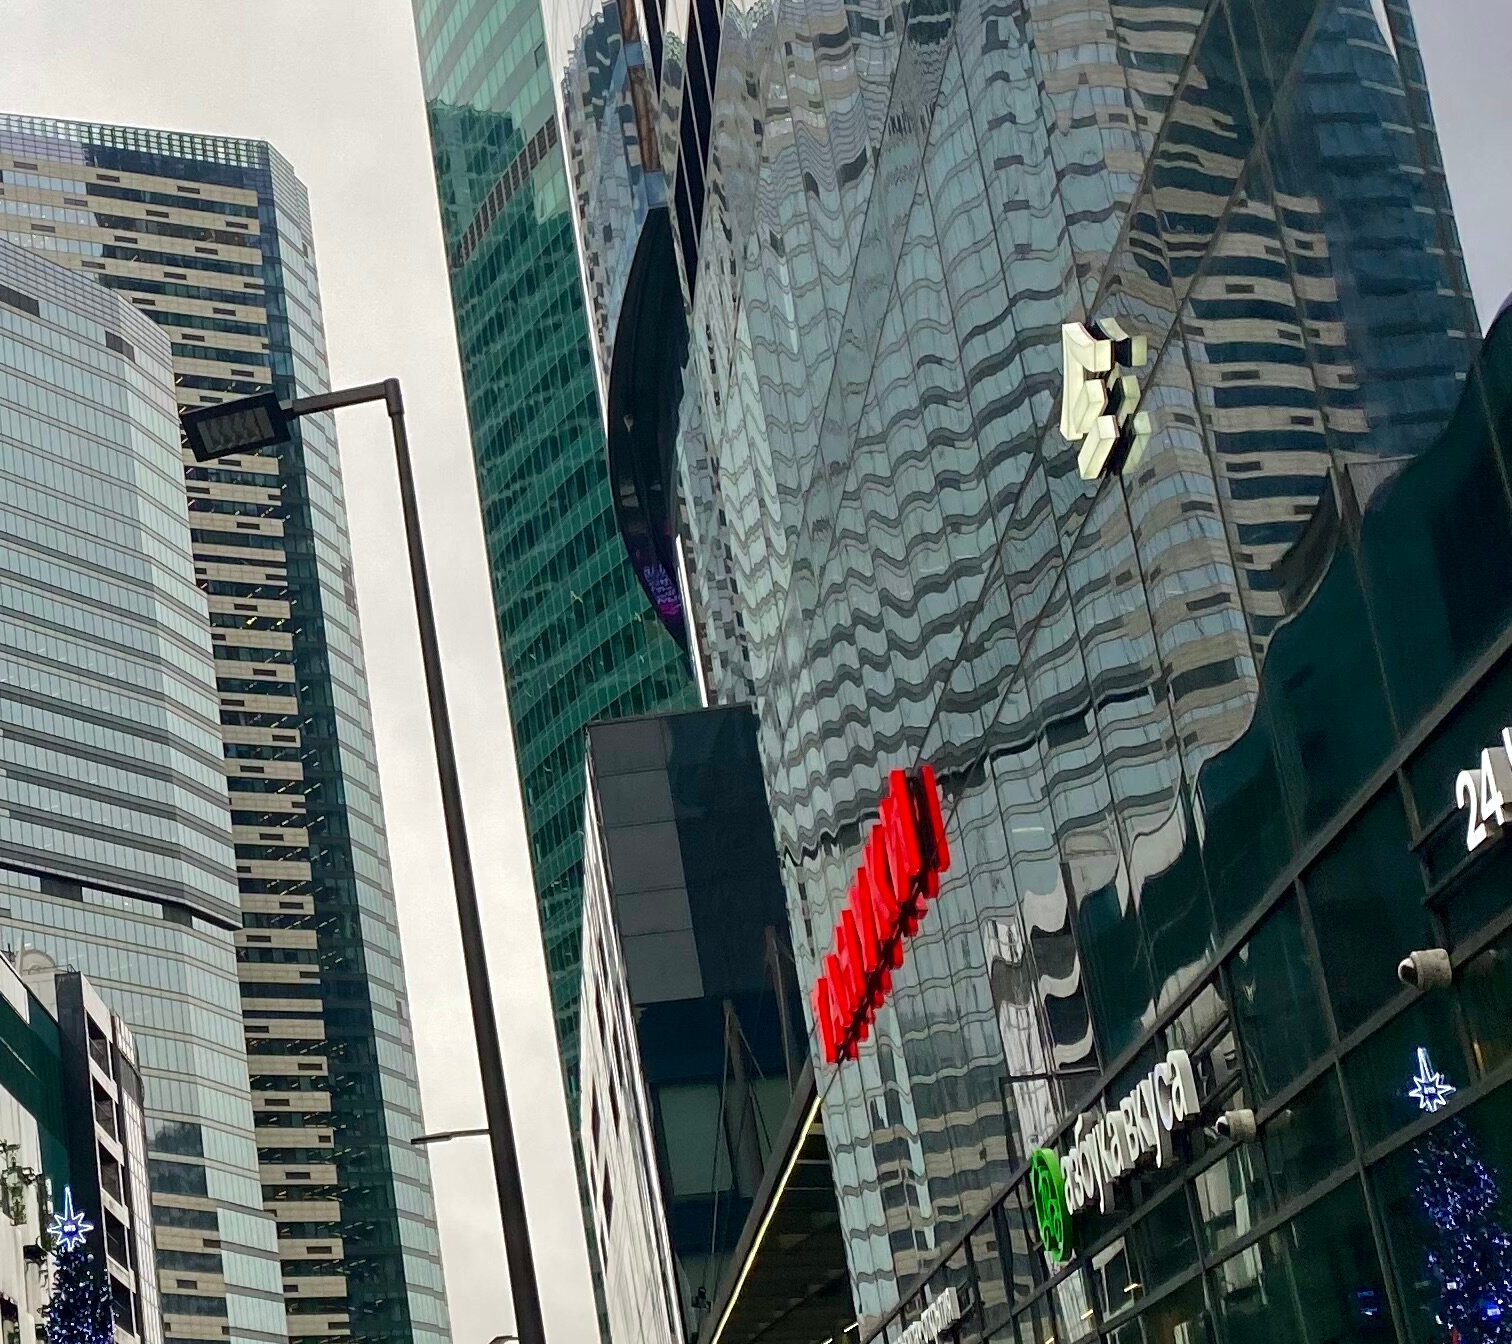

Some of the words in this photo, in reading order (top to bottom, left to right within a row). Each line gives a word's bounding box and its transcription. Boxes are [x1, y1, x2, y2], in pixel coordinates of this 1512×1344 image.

[1455, 747, 1505, 852] 24
[1060, 1112, 1136, 1215] азбука
[1120, 1049, 1201, 1169] вкуса
